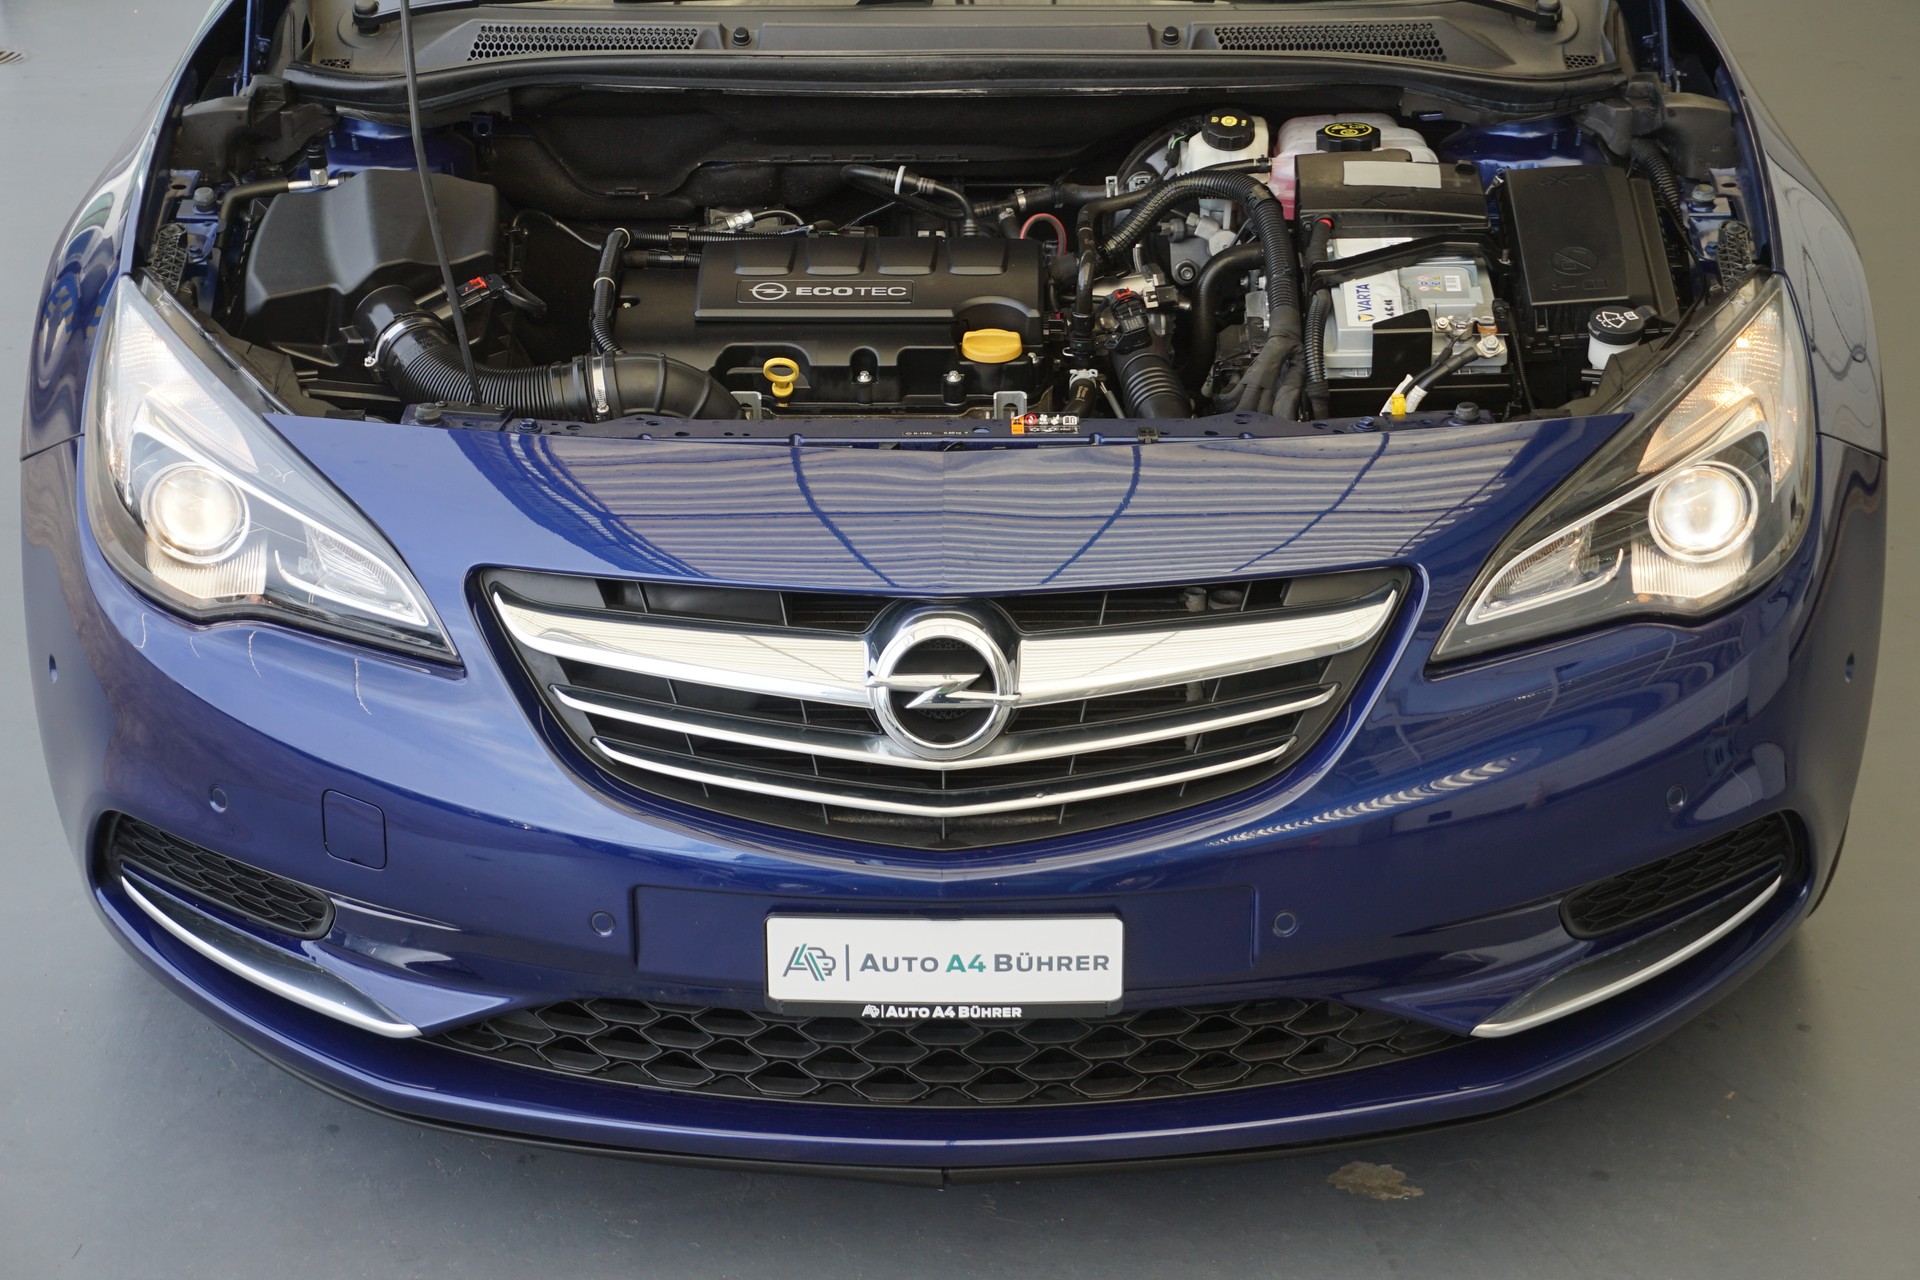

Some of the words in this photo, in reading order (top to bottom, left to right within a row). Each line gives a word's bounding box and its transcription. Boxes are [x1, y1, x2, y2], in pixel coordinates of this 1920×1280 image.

[795, 286, 907, 296] ECOTEC
[1355, 283, 1373, 312] VARTA
[859, 953, 939, 973] AUTO
[945, 953, 987, 973] A4
[994, 952, 1110, 973] BÜHRER
[885, 1005, 930, 1018] AUTO
[932, 1005, 956, 1018] A4
[958, 1005, 1022, 1018] BÜHRER
